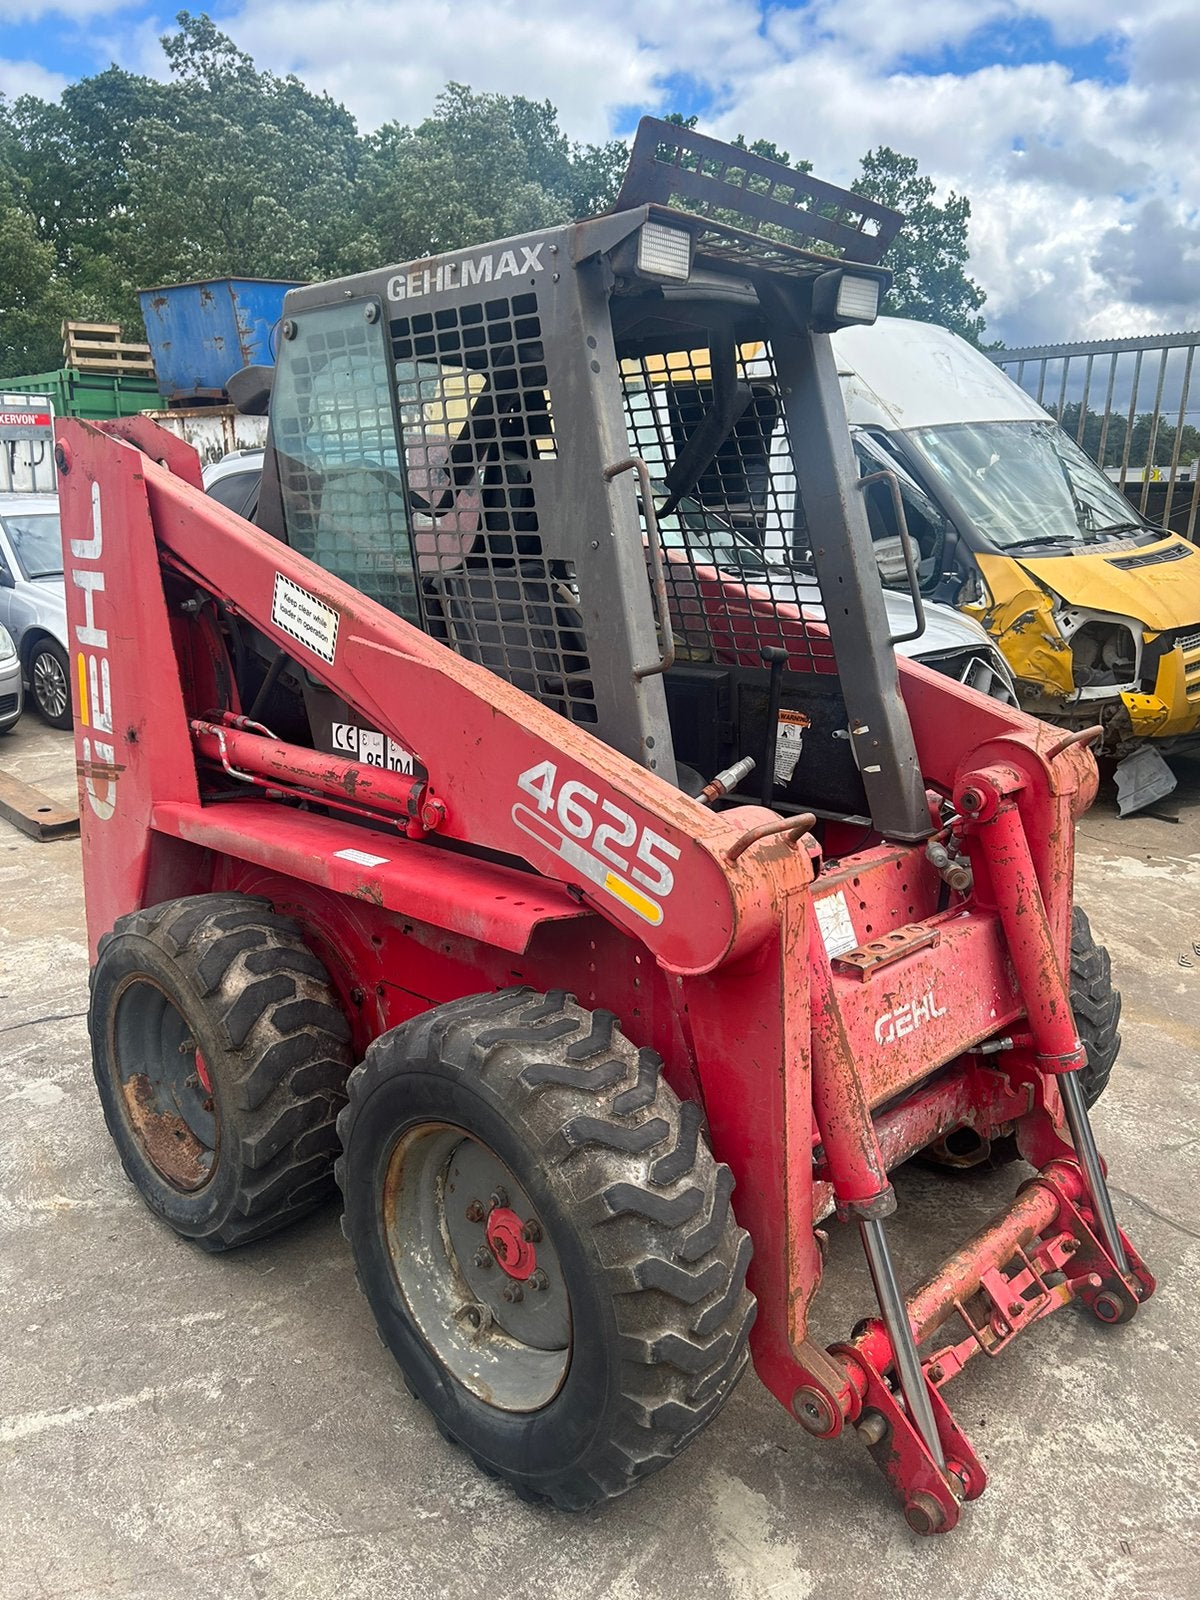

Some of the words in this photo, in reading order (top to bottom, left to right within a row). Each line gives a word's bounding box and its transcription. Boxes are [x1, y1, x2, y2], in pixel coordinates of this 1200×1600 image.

[387, 242, 545, 302] GEHLMAX
[280, 603, 297, 619] loader
[297, 615, 303, 624] in
[302, 620, 329, 644] operation
[283, 592, 298, 608] Keep
[298, 604, 312, 617] clear
[312, 613, 328, 629] while
[335, 724, 355, 751] CE
[517, 759, 682, 897] 4625
[874, 990, 948, 1046] GEHL
